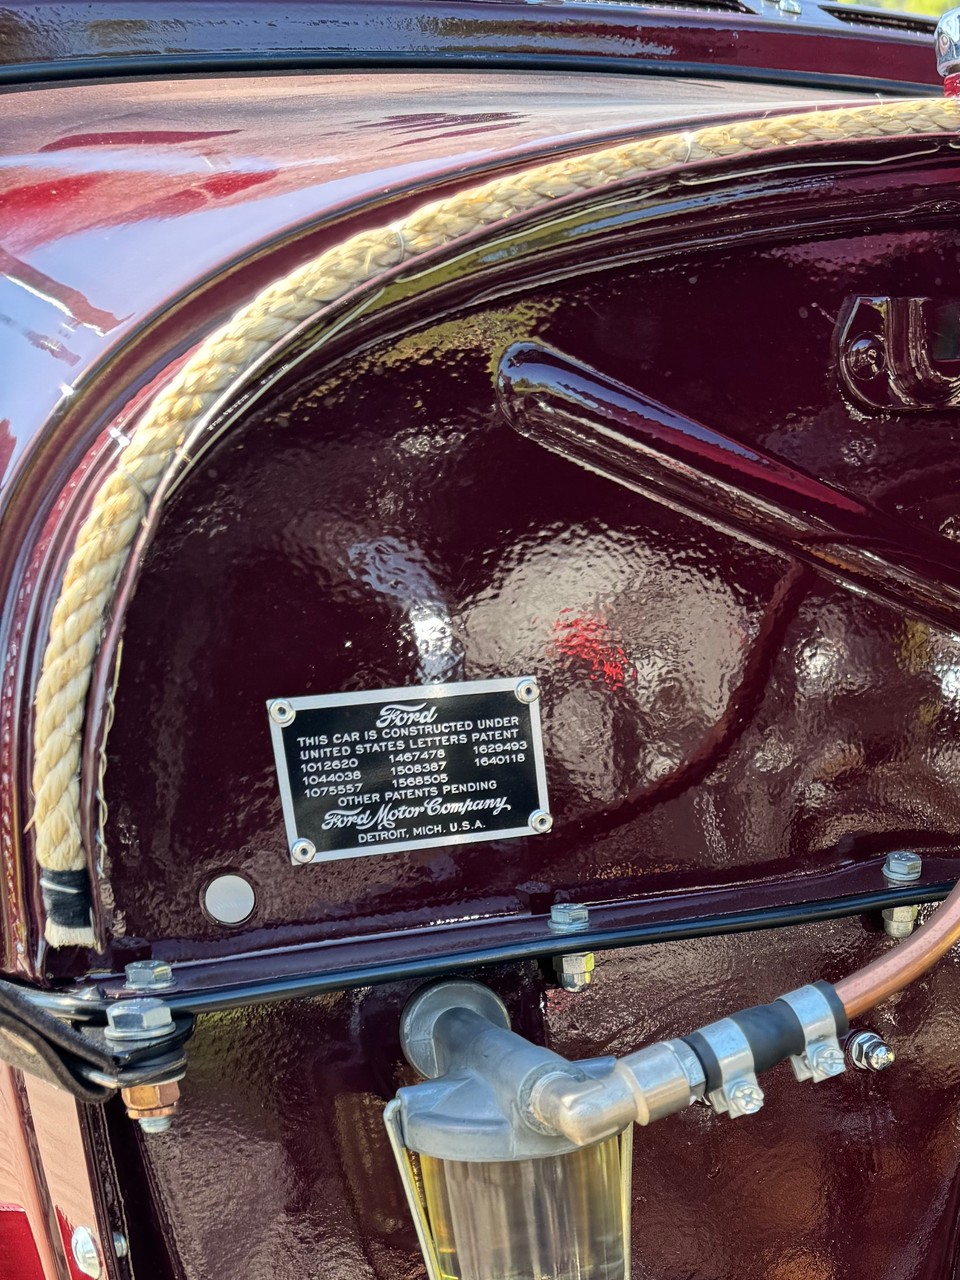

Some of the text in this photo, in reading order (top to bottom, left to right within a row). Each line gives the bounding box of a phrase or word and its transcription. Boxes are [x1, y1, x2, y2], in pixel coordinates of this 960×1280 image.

[376, 702, 438, 728] Ford
[297, 716, 519, 747] THIS CAR IS CONSTRUCTED UNDER
[300, 729, 519, 760] UNITED STATES LETTERS PATENT
[301, 741, 527, 773] 1012620 1467478 1629493
[302, 753, 525, 785] 1044038 1508387 1640118
[304, 773, 449, 798] 1075557 1568505
[338, 780, 498, 807] OTHER PATENTS PENDING
[321, 796, 512, 830] Ford Motor Company
[358, 819, 486, 843] DETROIT, MICH. U.S.A.
